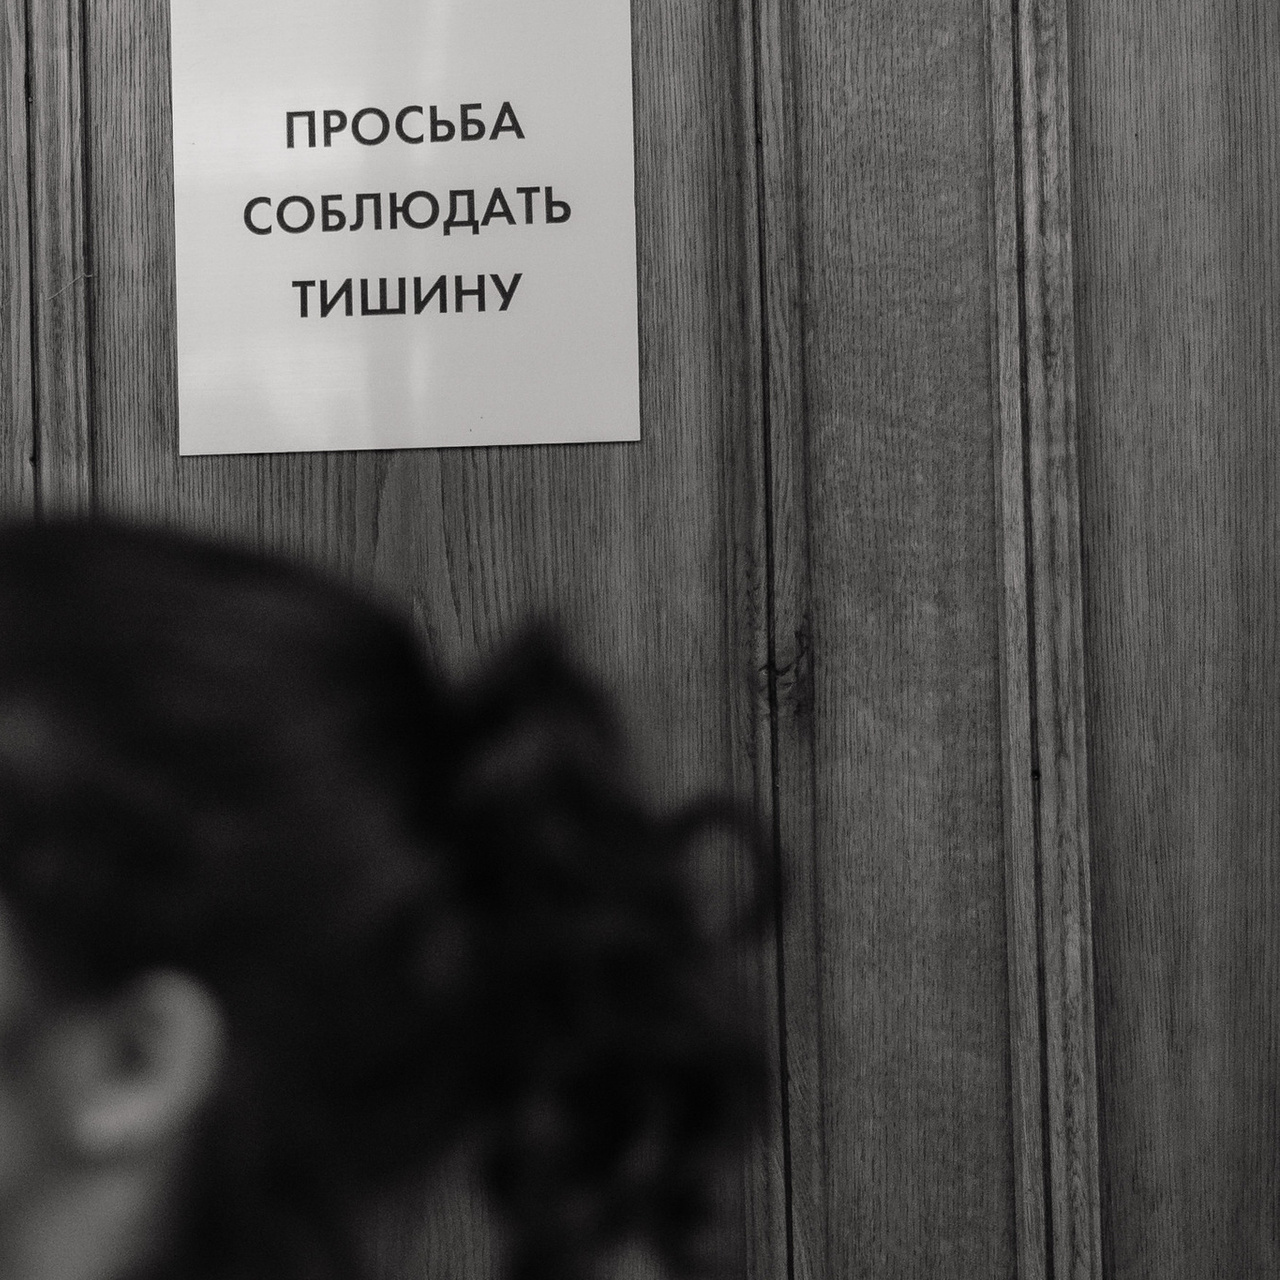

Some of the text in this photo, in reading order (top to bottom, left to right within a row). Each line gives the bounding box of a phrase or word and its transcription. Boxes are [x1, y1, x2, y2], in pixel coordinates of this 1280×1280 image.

[286, 101, 526, 149] ПРОСЬБА
[243, 186, 572, 237] СОБЛЮДАТЬ
[291, 272, 523, 318] ТИШИНУ
